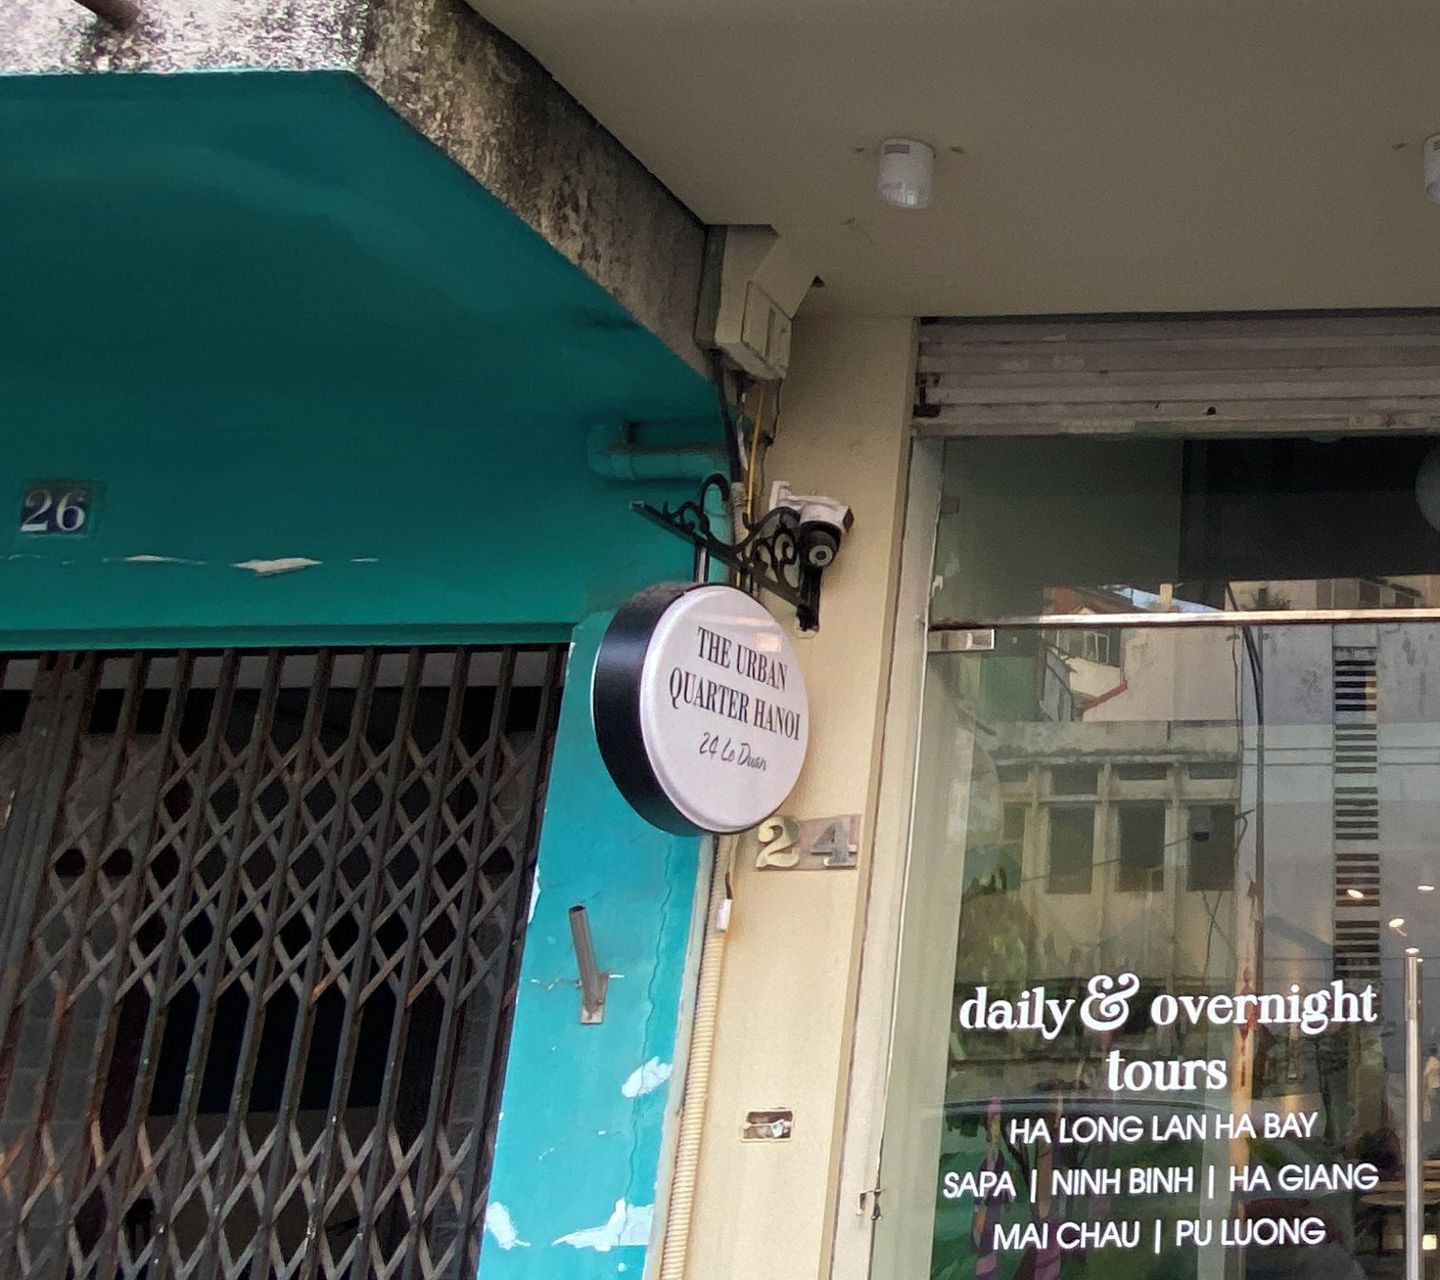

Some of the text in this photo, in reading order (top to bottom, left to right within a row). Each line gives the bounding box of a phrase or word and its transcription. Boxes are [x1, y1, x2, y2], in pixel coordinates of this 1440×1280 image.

[19, 487, 87, 534] 26
[698, 626, 788, 692] THE URBAN
[669, 667, 801, 741] QUARTER HANOI
[737, 743, 767, 771] Duan
[755, 816, 858, 871] 24
[958, 972, 1379, 1041] daily & overnight
[1106, 1049, 1228, 1092] tours
[1009, 1111, 1319, 1145] HA LONG LAN HA BAY
[942, 1170, 1017, 1200] SAPA
[1050, 1167, 1122, 1197] NINH
[1128, 1165, 1196, 1195] BINH
[1229, 1163, 1272, 1193] HA
[1277, 1162, 1381, 1192] GIANG
[993, 1221, 1049, 1251] MAI
[1055, 1220, 1142, 1250] CHAU
[1175, 1218, 1214, 1247] PU
[1220, 1217, 1327, 1246] LUONG
